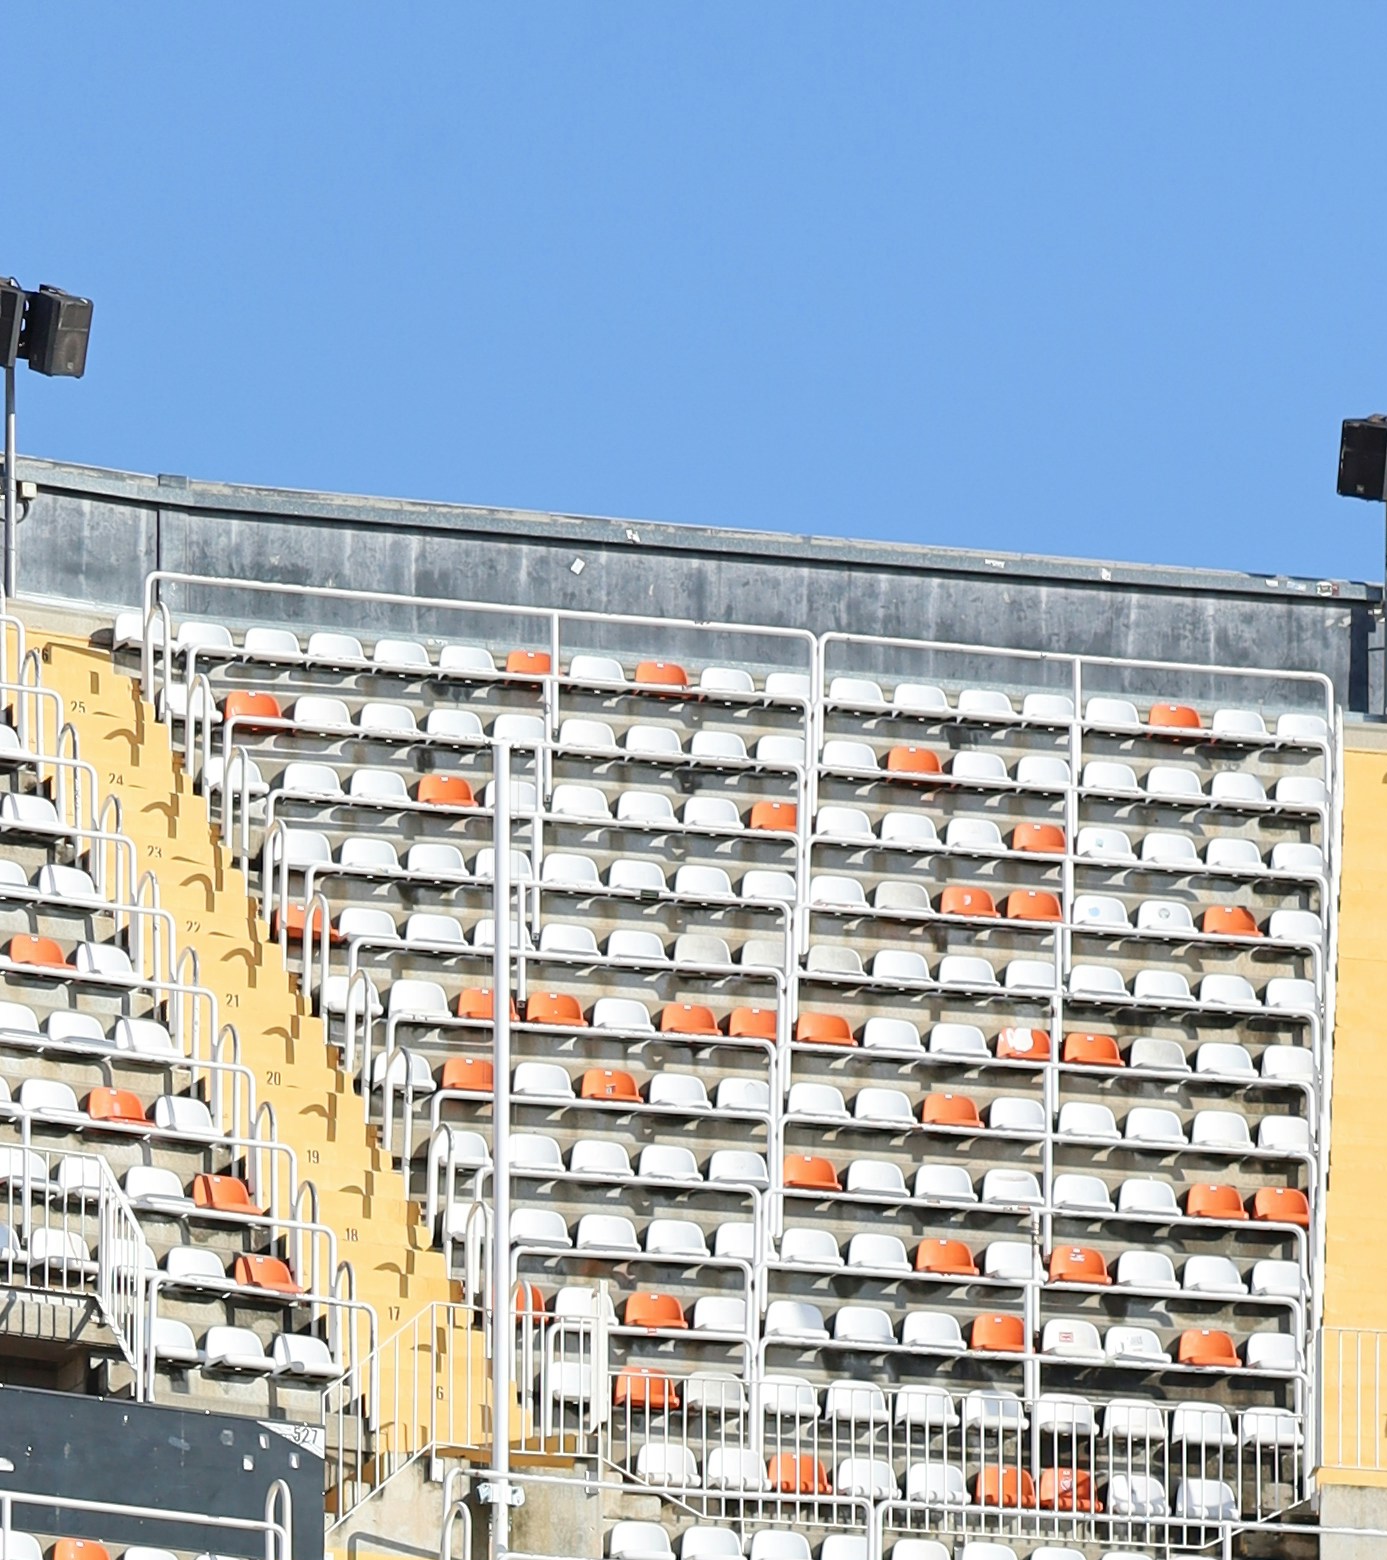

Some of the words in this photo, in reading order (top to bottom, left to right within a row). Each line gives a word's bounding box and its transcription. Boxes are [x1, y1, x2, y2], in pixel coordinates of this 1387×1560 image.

[71, 700, 86, 714] 25
[108, 773, 124, 786] 24
[147, 846, 163, 859] 23
[186, 920, 202, 933] 22
[226, 994, 240, 1008] 21
[266, 1071, 281, 1086] 20
[307, 1149, 320, 1164] 19
[346, 1227, 359, 1242] 18
[389, 1306, 400, 1321] 17
[436, 1385, 443, 1400] 6
[292, 1422, 318, 1443] 527
